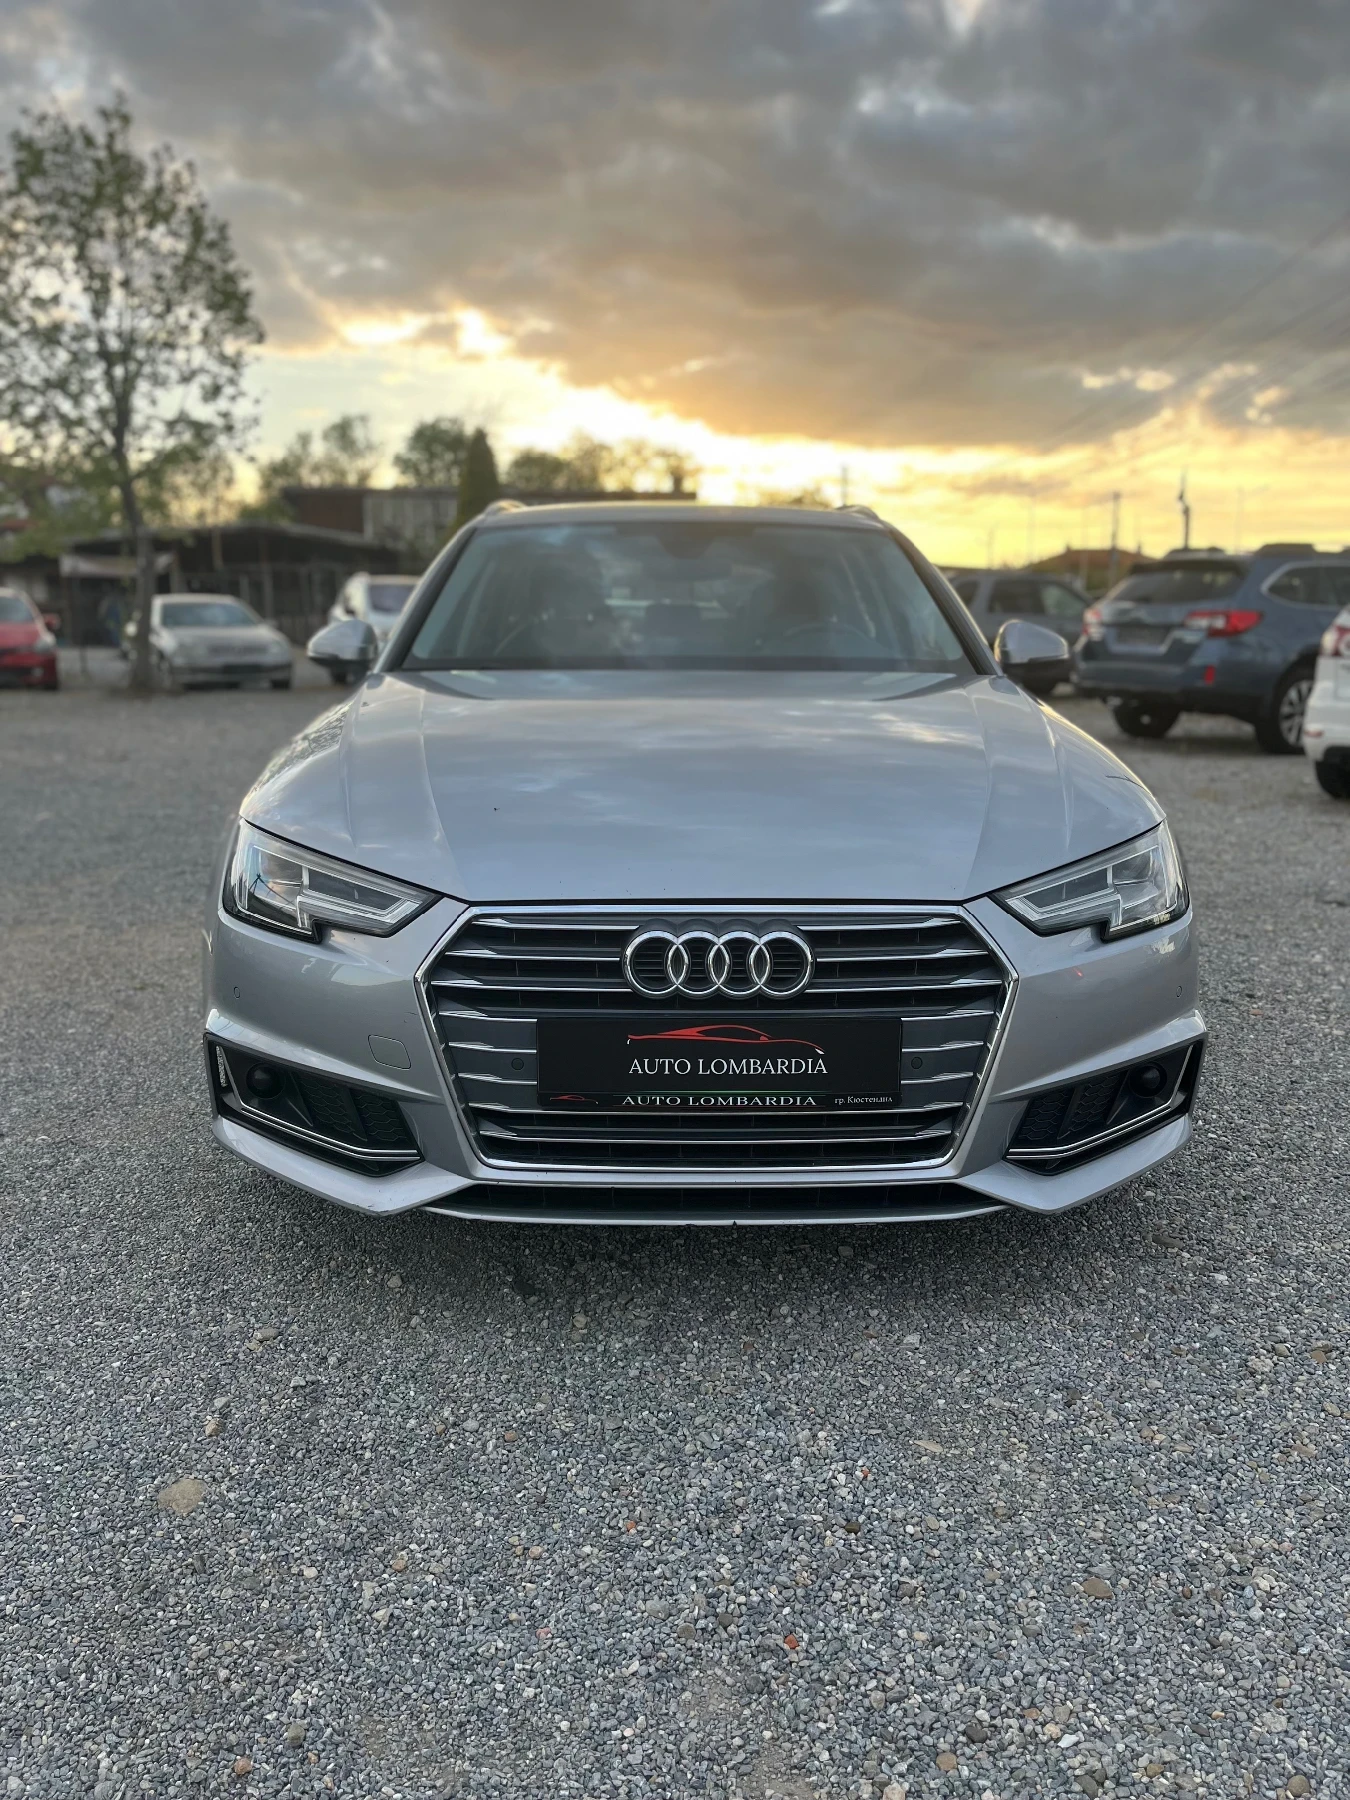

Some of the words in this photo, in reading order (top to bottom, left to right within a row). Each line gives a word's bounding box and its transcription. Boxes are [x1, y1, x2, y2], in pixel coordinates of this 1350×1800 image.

[628, 1058, 691, 1075] AUTO
[697, 1057, 828, 1075] LOMBARDIA
[622, 1096, 681, 1106] AUTO
[688, 1096, 817, 1106] LOMBARDIA
